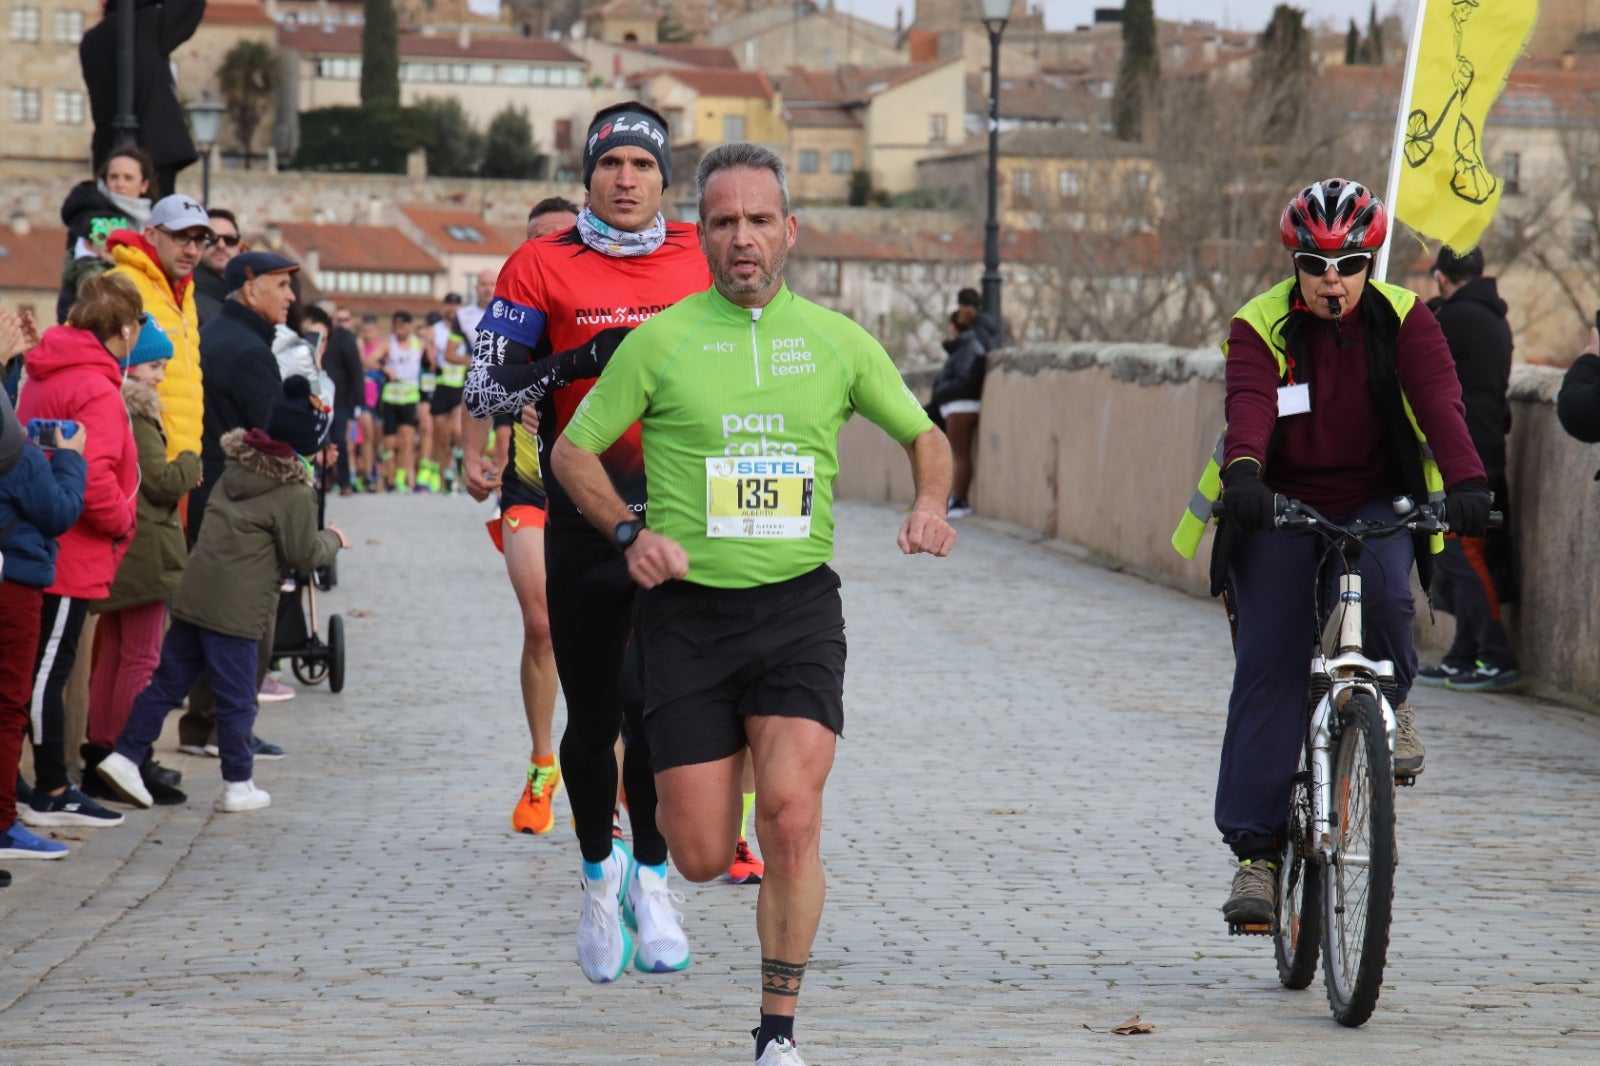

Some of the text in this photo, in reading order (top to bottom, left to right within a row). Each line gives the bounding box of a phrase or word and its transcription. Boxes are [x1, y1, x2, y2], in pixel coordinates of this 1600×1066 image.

[588, 116, 665, 156] POLAR
[771, 337, 806, 351] pan
[771, 348, 812, 363] cake
[771, 363, 817, 377] team
[721, 413, 785, 439] pan
[737, 462, 806, 474] SETEL
[736, 478, 779, 509] 135
